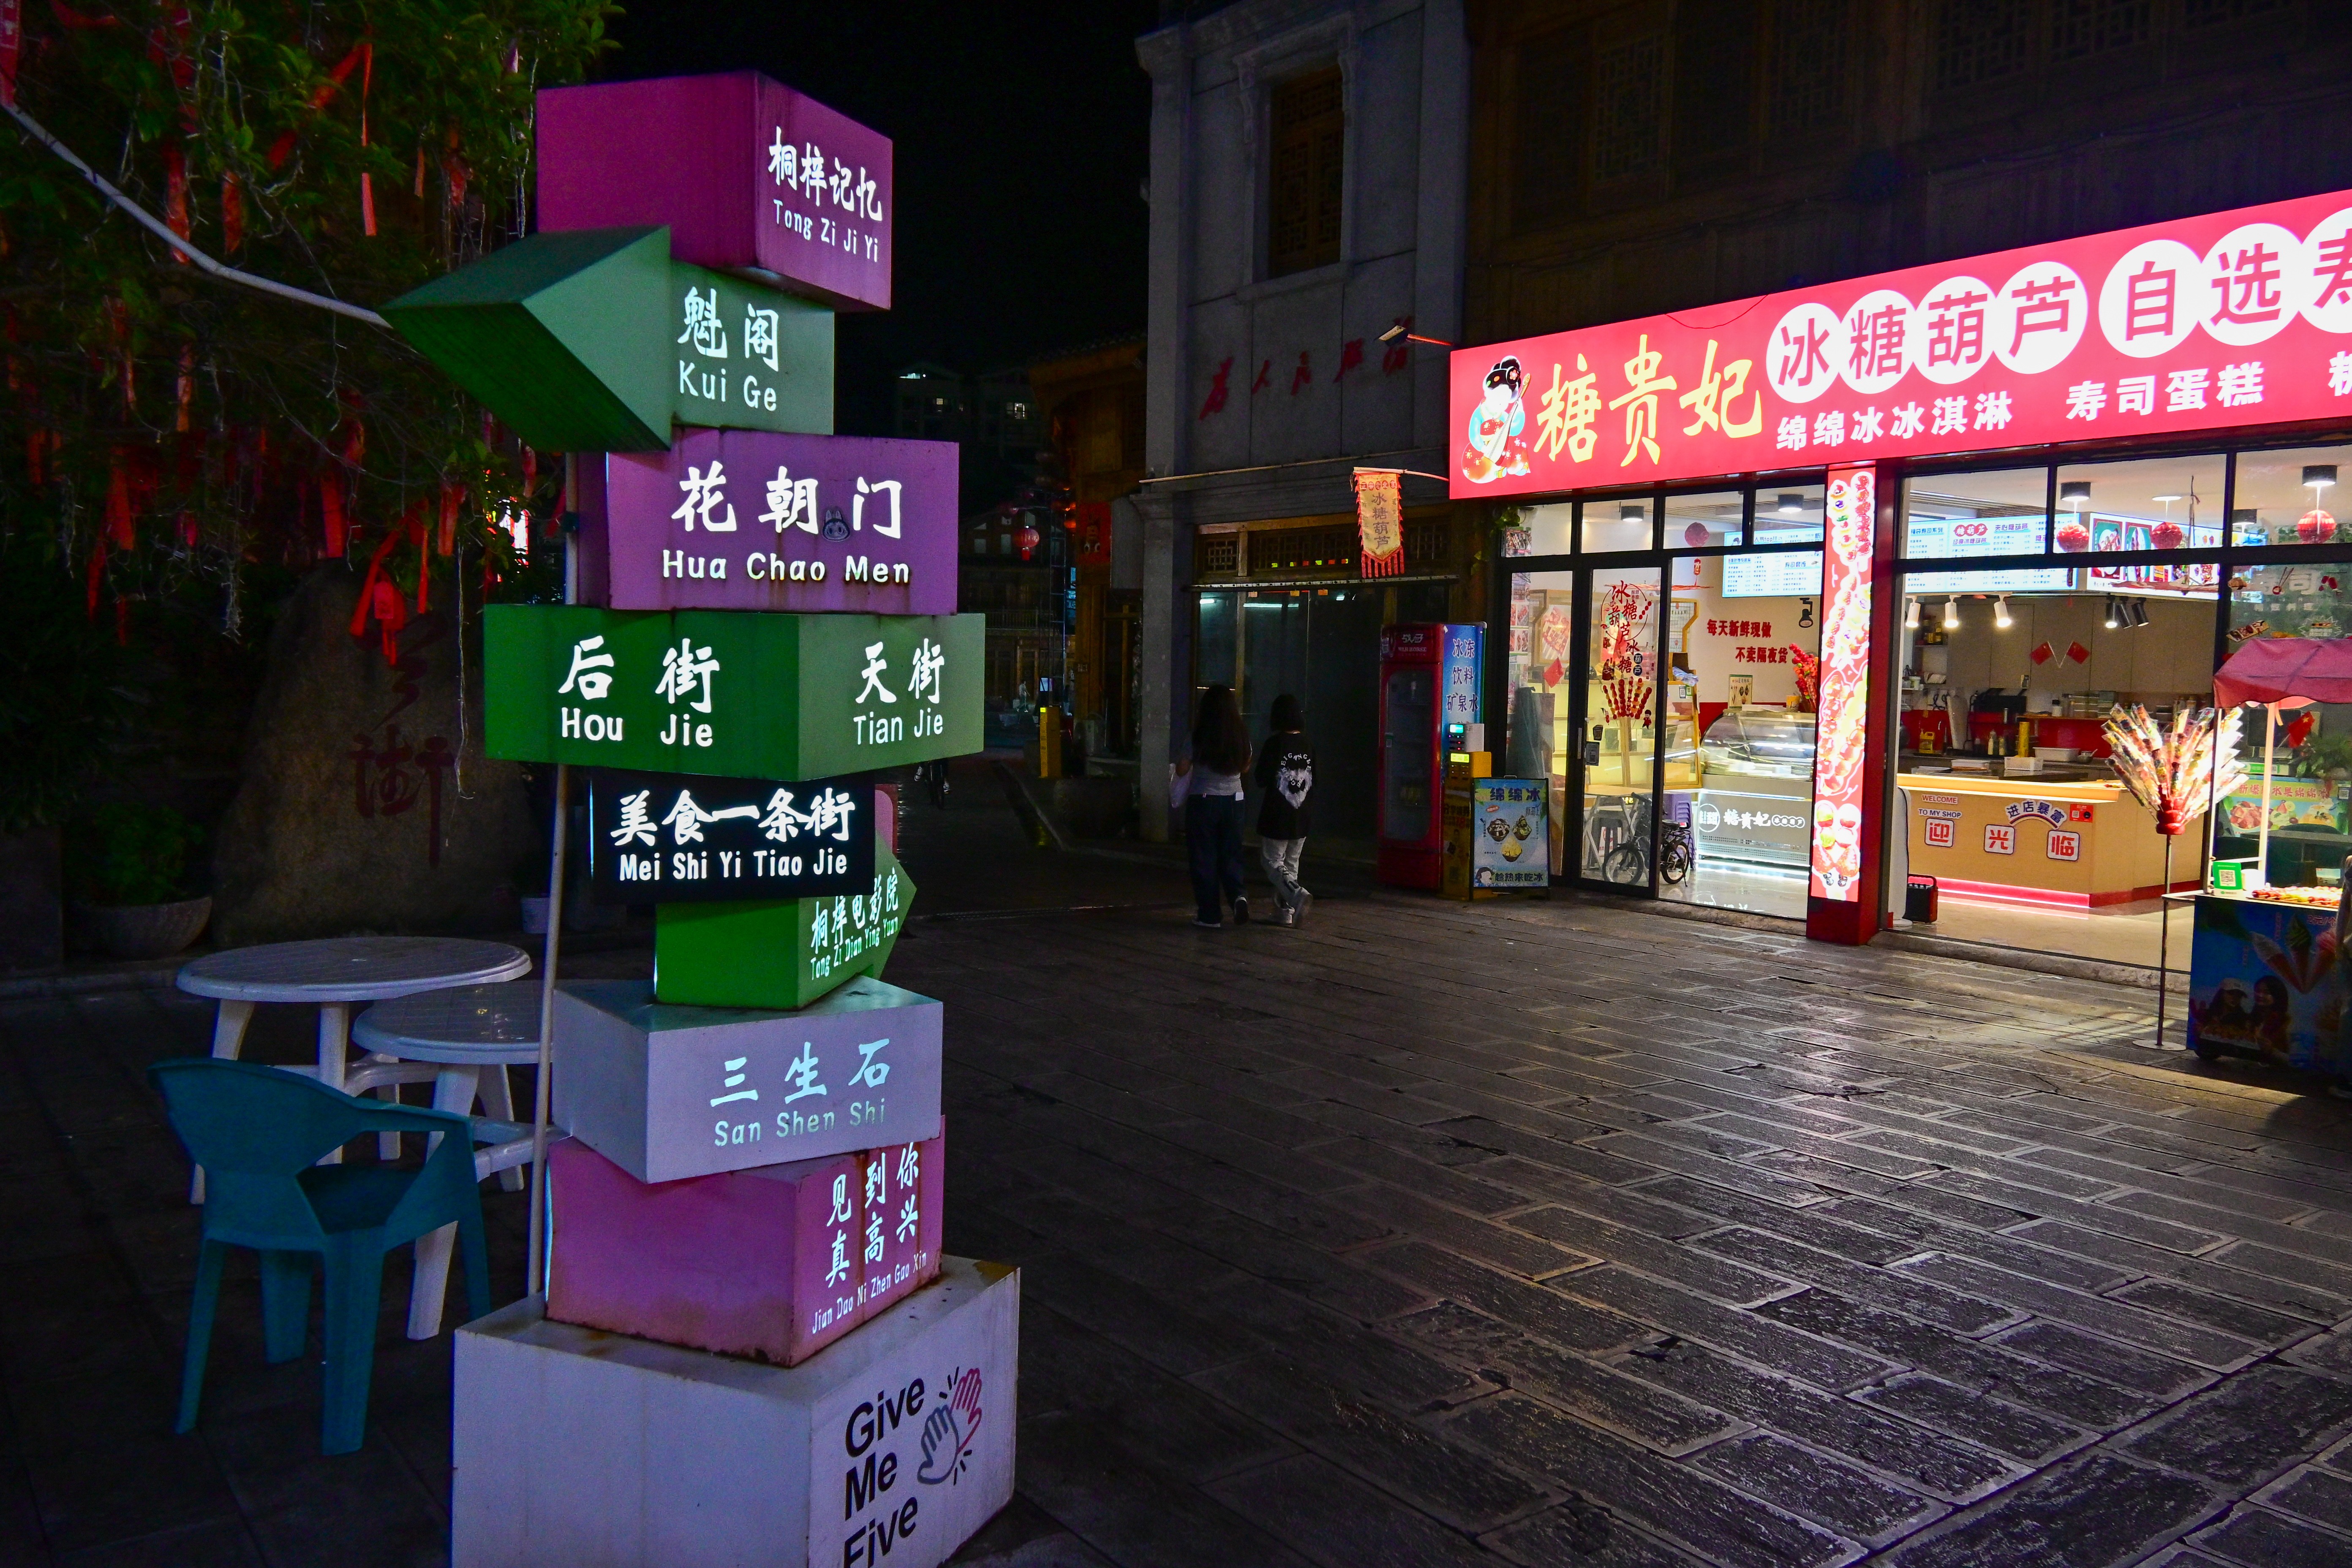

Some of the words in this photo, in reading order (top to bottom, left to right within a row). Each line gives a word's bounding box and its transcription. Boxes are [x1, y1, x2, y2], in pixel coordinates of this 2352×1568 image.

[768, 126, 882, 221] 桐梓记忆
[774, 200, 812, 240] Tong
[821, 218, 835, 245] Zi
[844, 229, 856, 254] Ji
[865, 235, 877, 262] Yi
[677, 286, 779, 371] 魁阁
[1778, 276, 2075, 387] 冰糖葫芦
[680, 360, 726, 402] Kui
[744, 376, 776, 411] Ge
[1534, 334, 1762, 466] 糖贵妃
[1777, 391, 2012, 451] 绵绵冰冰淇淋
[2066, 362, 2264, 421] 寿司蛋糕
[672, 461, 901, 538] 花朝门
[1372, 493, 1390, 549] 冰糖葫芦
[1956, 525, 1985, 535] 糖葫芦
[663, 550, 726, 578] Hua
[747, 553, 825, 580] Chao
[846, 556, 908, 582] Men
[1608, 580, 1637, 644] 冰糖葫芦
[1707, 619, 1772, 638] 每天新鲜现做
[559, 636, 720, 713] 后街
[856, 638, 944, 703] 天街
[1452, 638, 1475, 658] 冰冻
[1452, 667, 1474, 686] 饮料
[1735, 646, 1788, 663] 不卖隔夜货
[562, 708, 622, 740] Hou
[661, 714, 712, 746] Jie
[854, 712, 902, 744] Tian
[915, 708, 942, 737] Jie
[1446, 694, 1479, 713] 矿泉水
[611, 788, 855, 846] 美食一条街
[1490, 787, 1541, 801] 绵绵冰
[1922, 795, 1957, 803] WELCOME
[2007, 801, 2064, 823] 进店暴富
[2240, 784, 2330, 799] 新爆水果绵绵冰
[620, 853, 659, 880] Mei
[673, 852, 707, 879] Shi
[720, 851, 740, 877] Yi
[754, 849, 802, 876] Tiao
[814, 848, 847, 874] Jie
[1495, 873, 1543, 882] 趁热来吃冰
[811, 867, 898, 954] 桐梓电影院
[811, 955, 830, 980] Tong
[834, 945, 841, 966] Zi
[845, 936, 861, 961] Dian
[865, 926, 880, 946] Ying
[883, 917, 898, 936] Yuan
[710, 1038, 890, 1106] 三生石
[714, 1120, 760, 1147] San
[776, 1111, 835, 1138] Shen
[850, 1097, 885, 1126] Shi
[826, 1142, 919, 1227] 见到你
[826, 1206, 918, 1288] 真高兴
[813, 1308, 832, 1334] Jian
[837, 1297, 853, 1319] Dao
[858, 1285, 866, 1306] Ni
[871, 1274, 890, 1298] Zhen
[895, 1264, 909, 1284] Gao
[913, 1250, 926, 1273] Xin
[846, 1377, 925, 1458] Give
[845, 1451, 897, 1519] Me
[844, 1496, 917, 1568] Five
